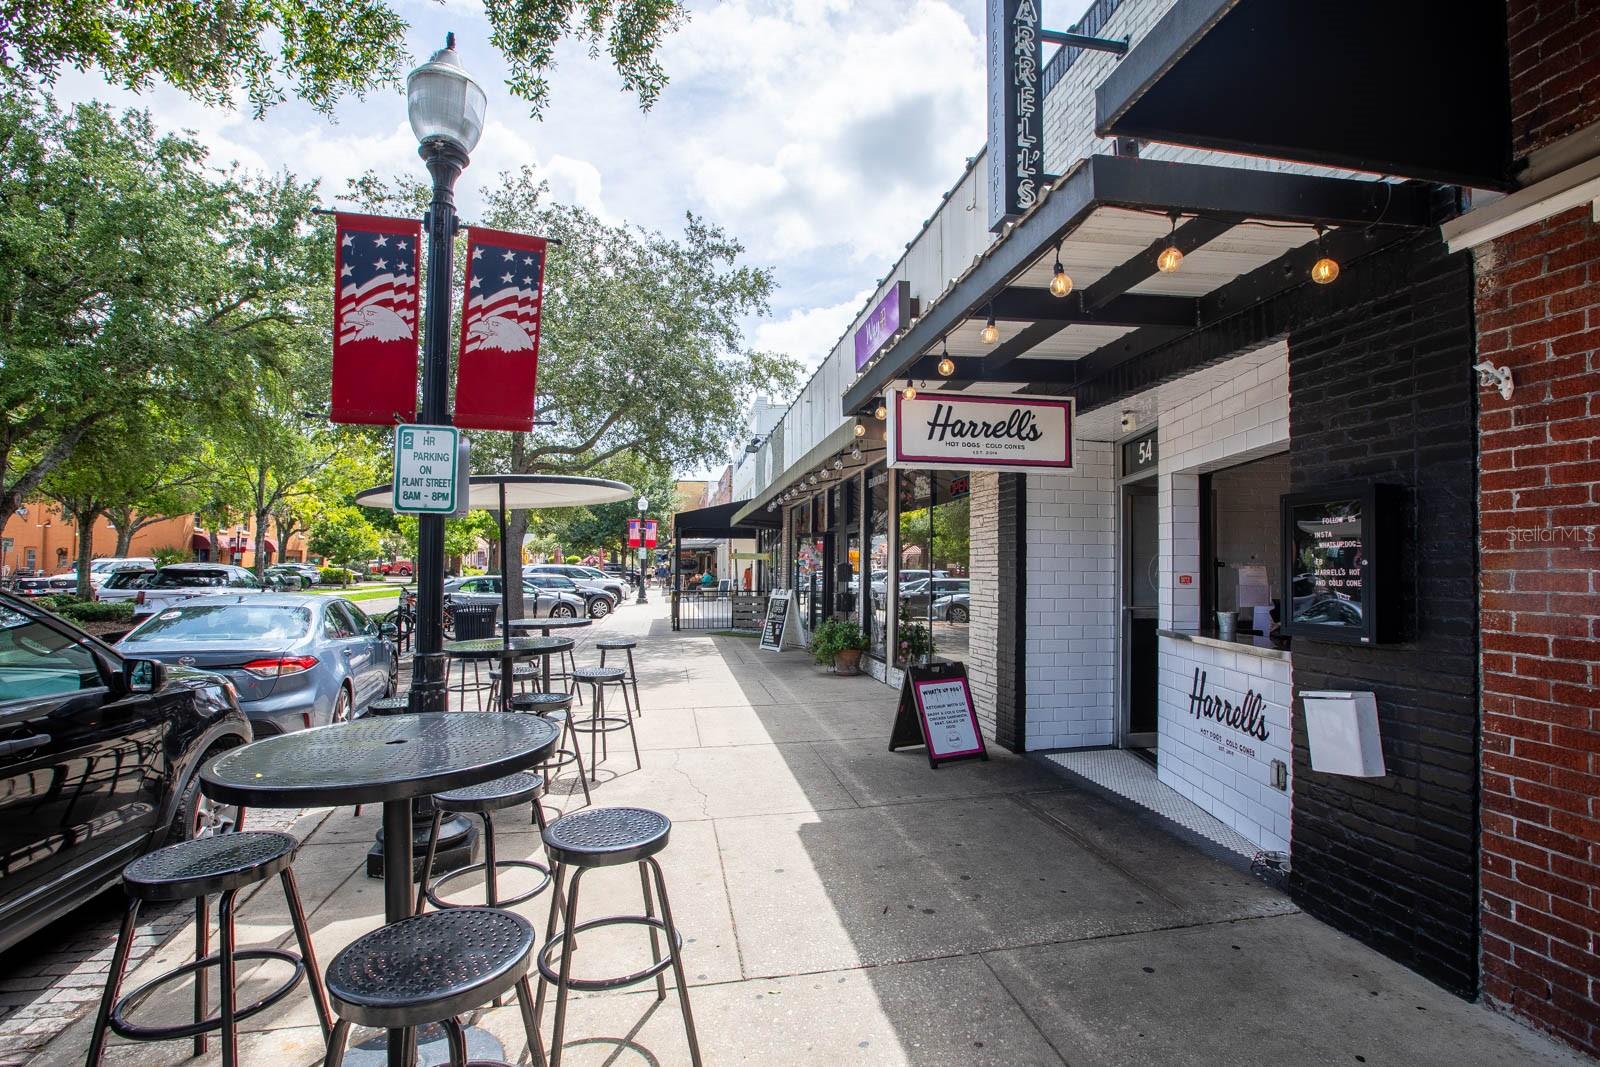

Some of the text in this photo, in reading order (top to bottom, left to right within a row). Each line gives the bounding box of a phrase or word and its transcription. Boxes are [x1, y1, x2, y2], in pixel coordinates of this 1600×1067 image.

[927, 404, 1043, 441] Harrell's
[404, 436, 435, 446] 2 HR
[414, 452, 449, 461] PARKING
[1138, 439, 1152, 464] 54
[419, 465, 431, 474] ON
[402, 477, 451, 487] PLANT STREET
[403, 491, 421, 500] 8AM
[432, 492, 449, 501] 8PM
[1189, 667, 1269, 741] Harrell's
[1210, 731, 1222, 742] DOGS
[1226, 739, 1237, 749] COLD
[1240, 745, 1255, 757] CONES
